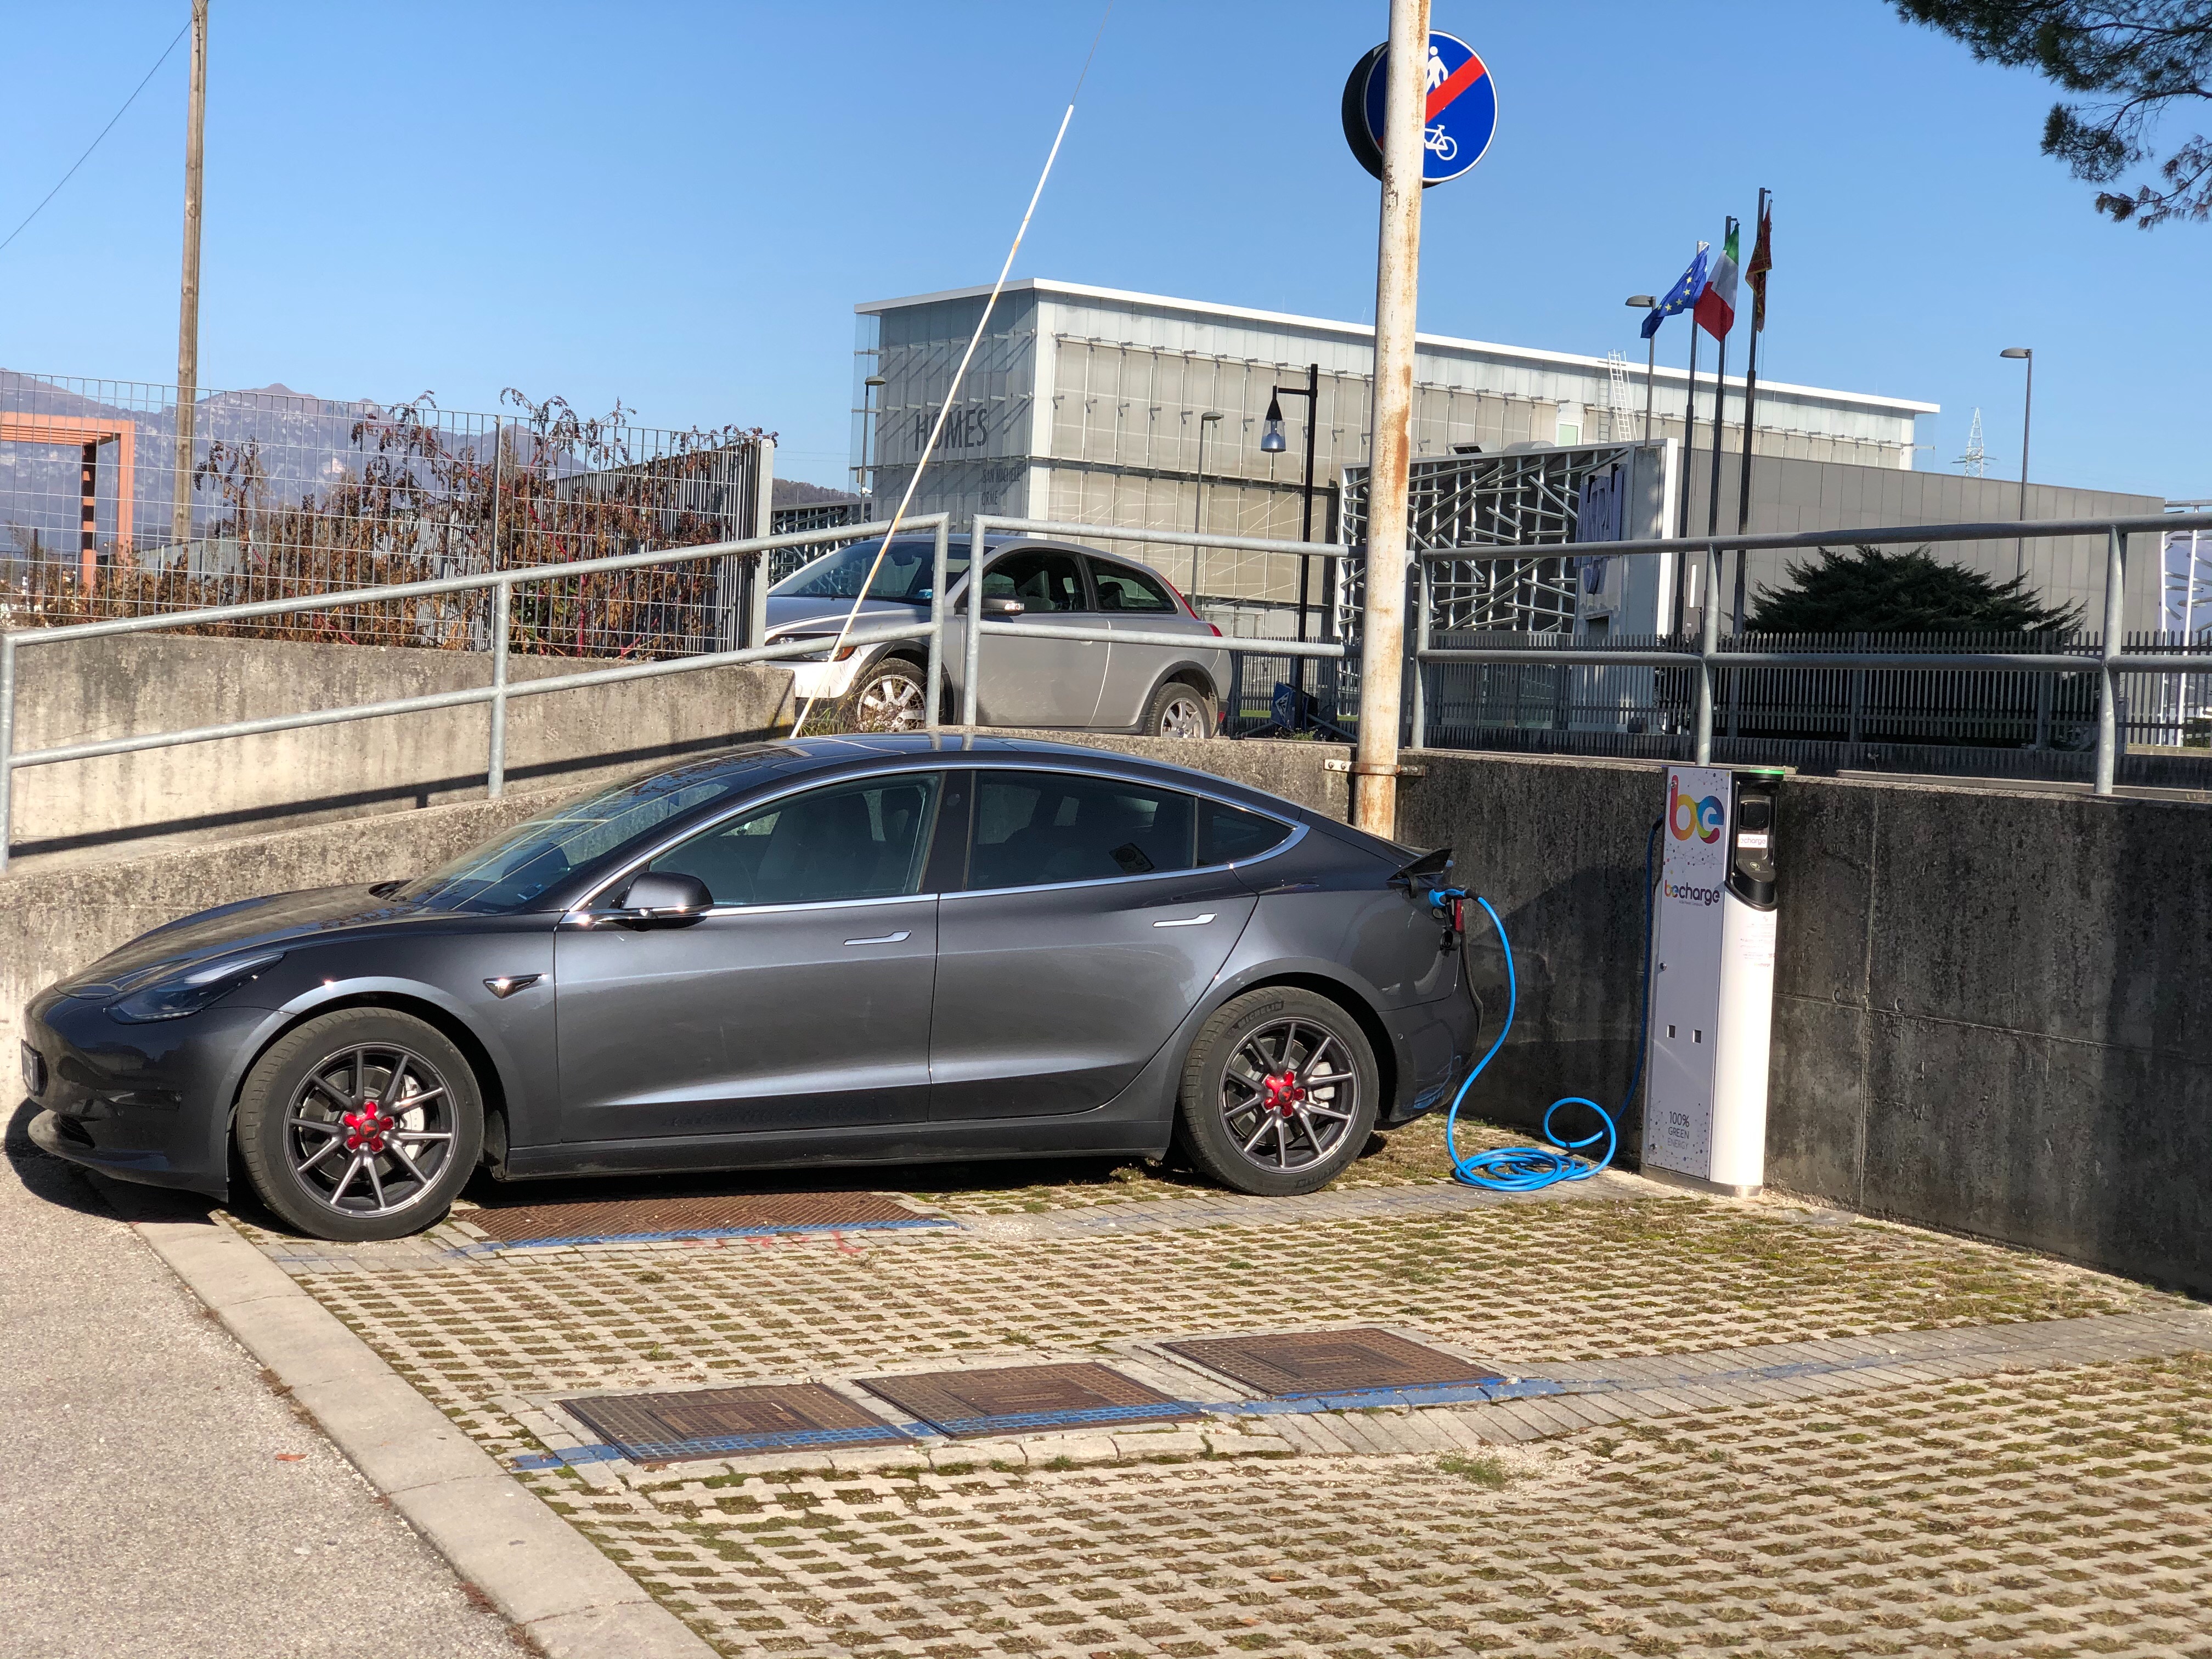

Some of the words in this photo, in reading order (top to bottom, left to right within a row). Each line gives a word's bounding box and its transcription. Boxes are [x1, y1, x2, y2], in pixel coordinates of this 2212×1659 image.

[915, 409, 987, 452] HOMES
[983, 468, 994, 483] SAN
[982, 490, 998, 505] ORME
[1669, 775, 1725, 844] be
[1664, 879, 1720, 906] becharge
[1238, 1002, 1283, 1029] MICHELIN
[1669, 1111, 1690, 1127] 100%
[1668, 1126, 1690, 1139] GREEN
[1668, 1137, 1689, 1150] ENERGY
